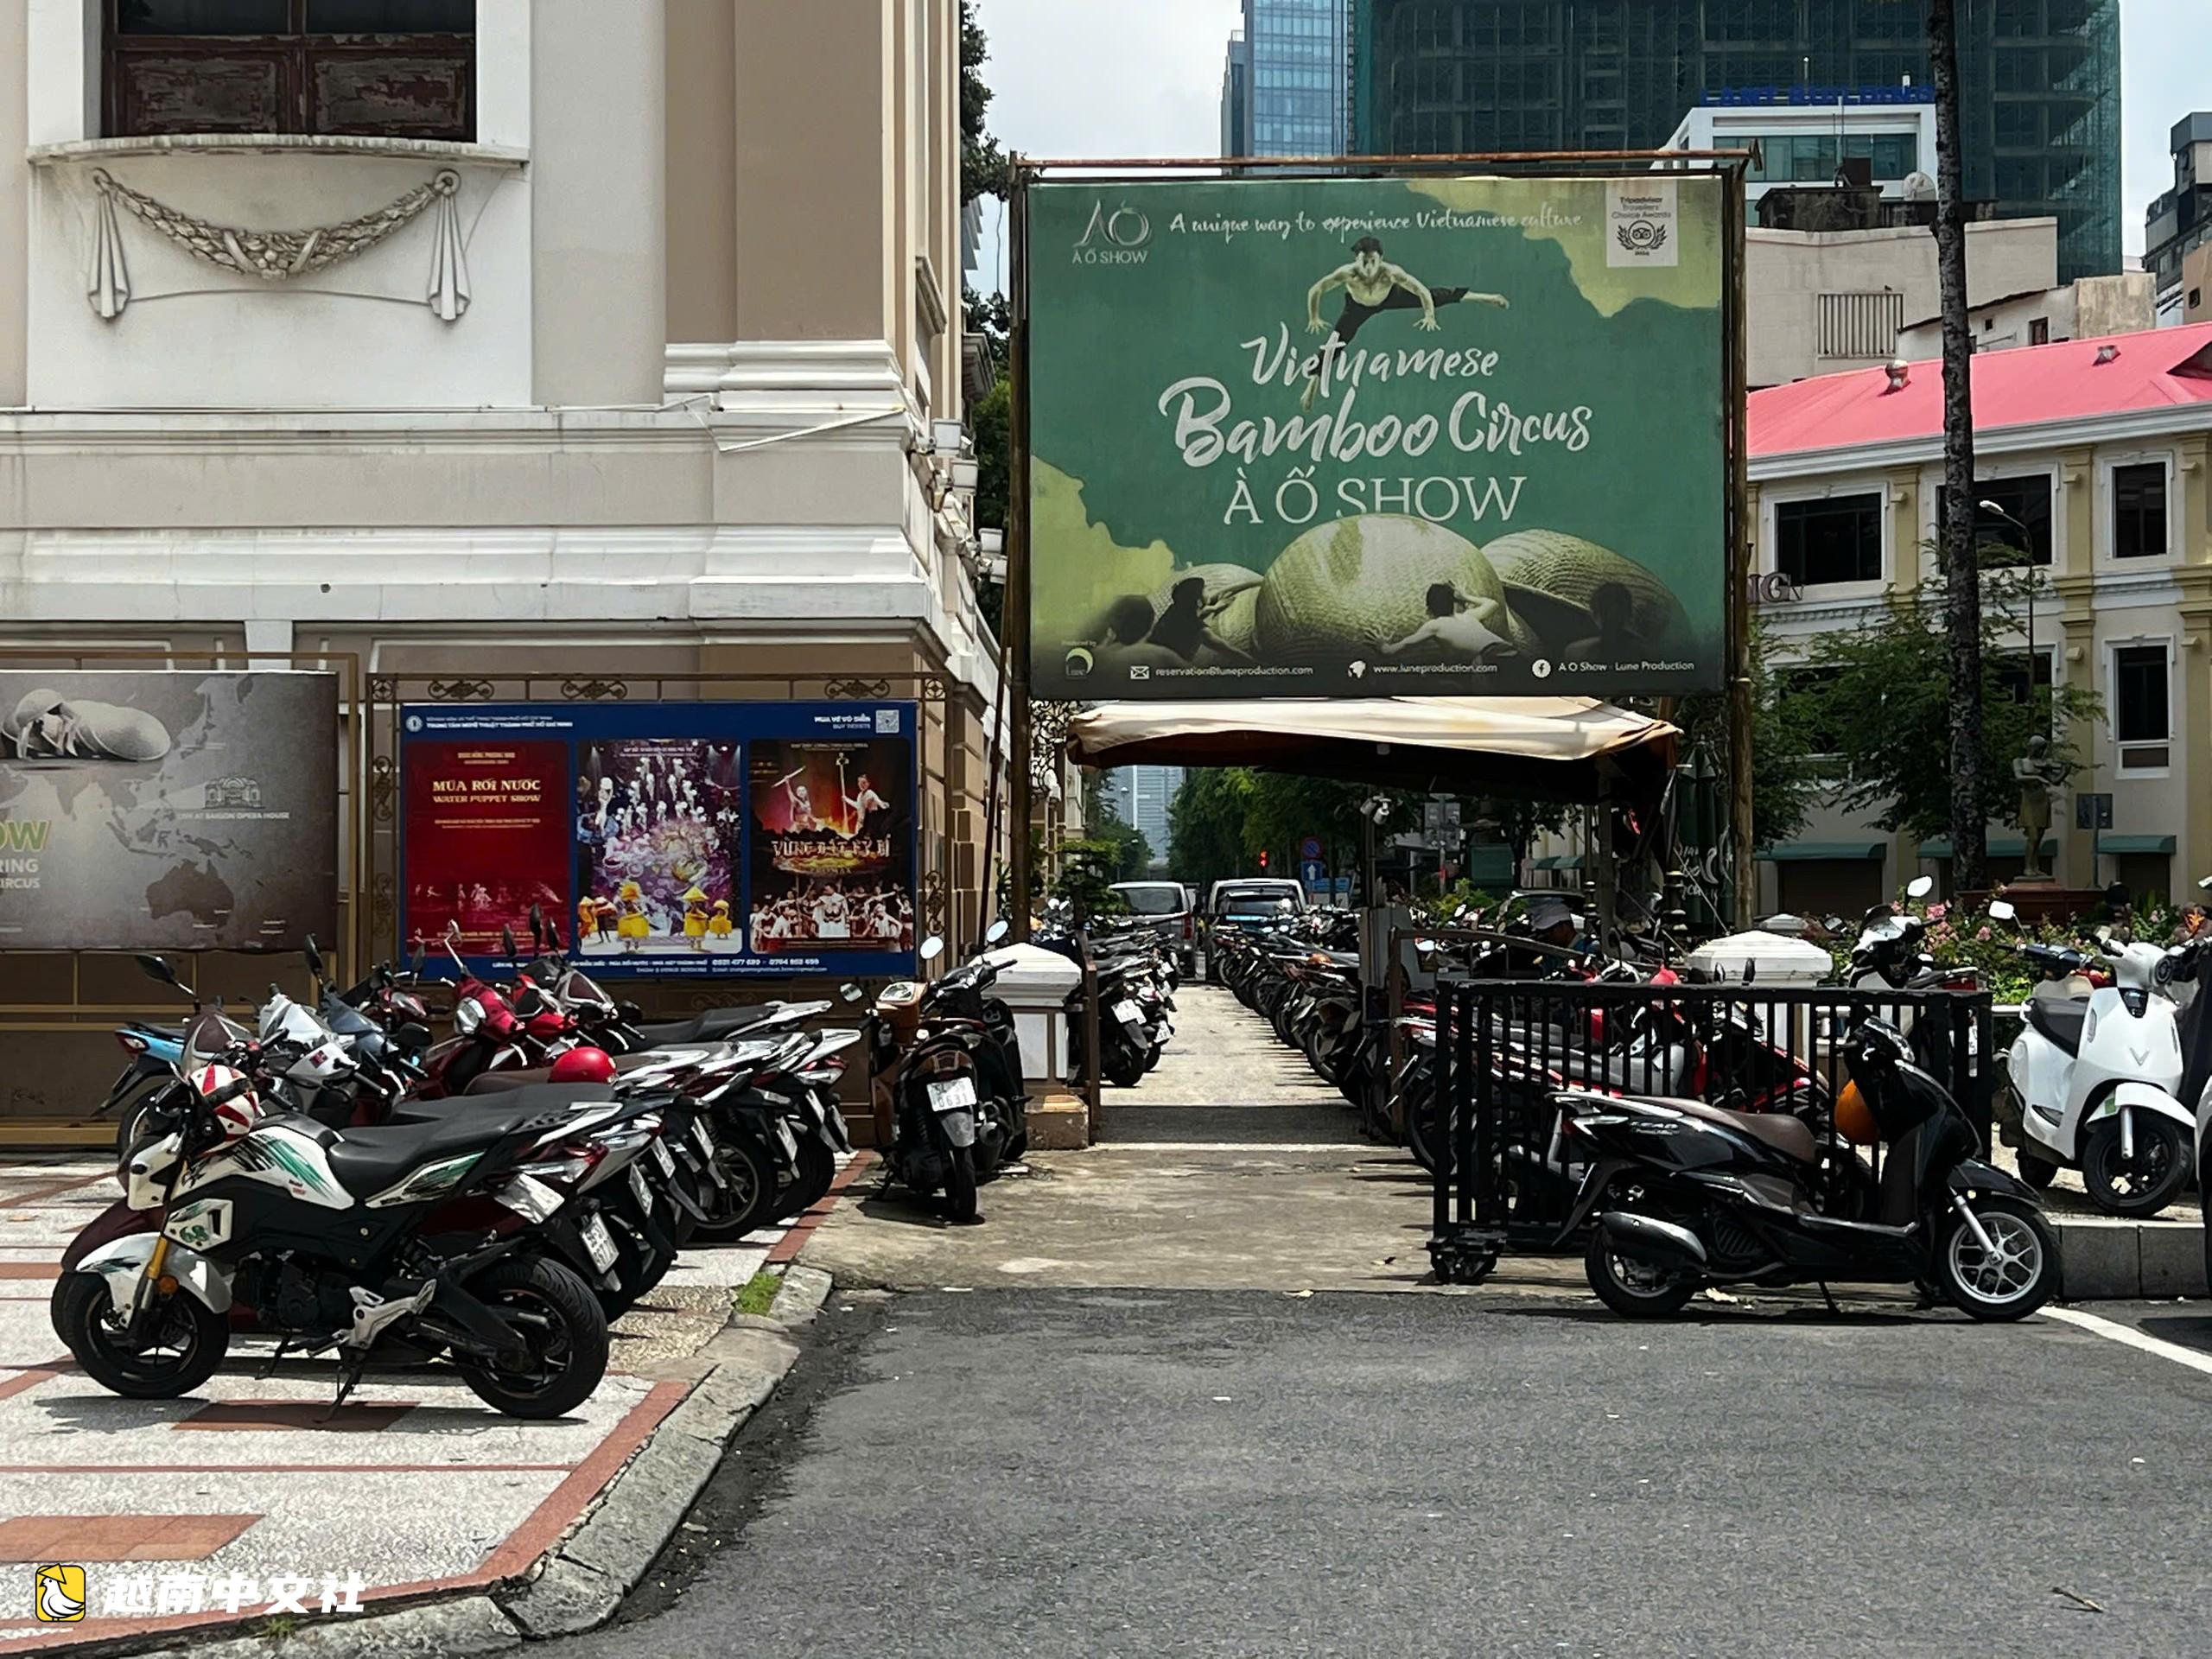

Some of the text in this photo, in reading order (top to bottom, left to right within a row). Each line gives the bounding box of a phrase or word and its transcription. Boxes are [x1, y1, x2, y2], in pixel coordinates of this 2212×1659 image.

[1170, 200, 1583, 244] A unique way to experience Vietnamese culture
[1099, 250, 1148, 264] SHOW
[1241, 321, 1499, 398] Vietnamese
[1158, 376, 1593, 468] Bamboo Circus
[1224, 465, 1528, 525] À Ố SHOW
[1155, 665, 1313, 677] reservation@luneproduction.com
[1373, 663, 1497, 675] www.luneproduction.com
[1580, 661, 1608, 671] Show
[1615, 661, 1640, 671] Lune
[1642, 660, 1695, 671] Production
[0, 878, 41, 889] IRCUS
